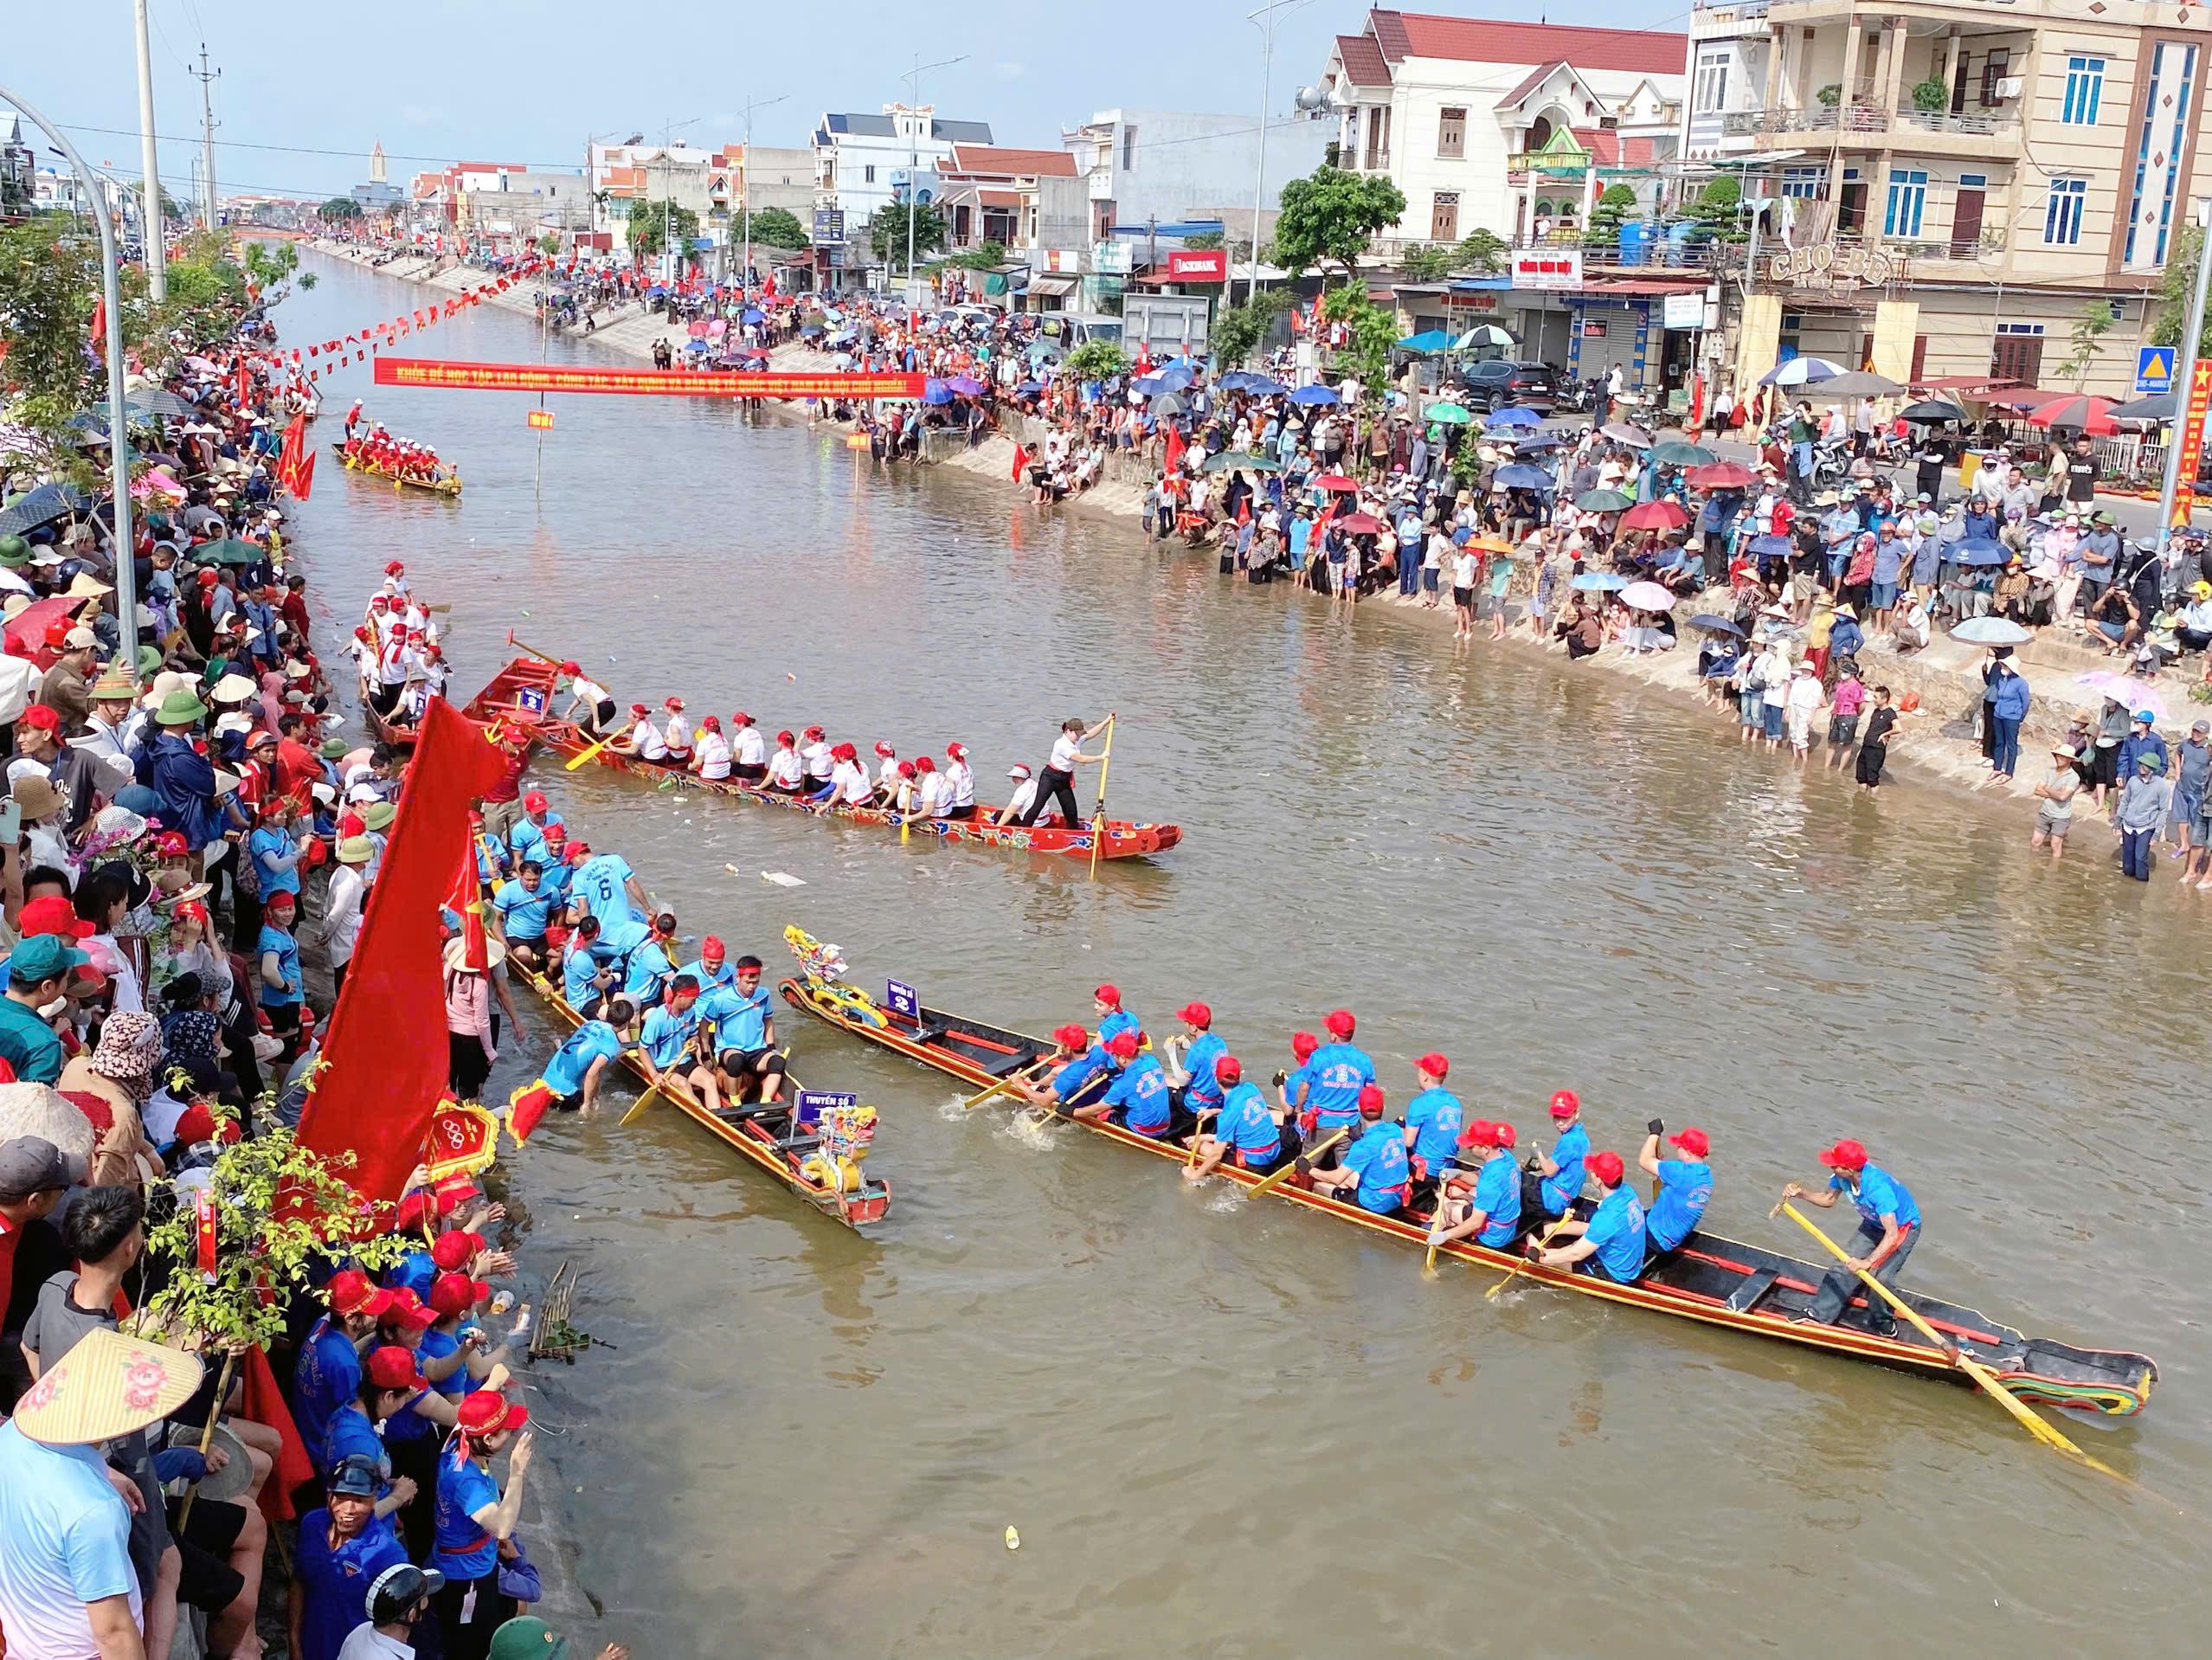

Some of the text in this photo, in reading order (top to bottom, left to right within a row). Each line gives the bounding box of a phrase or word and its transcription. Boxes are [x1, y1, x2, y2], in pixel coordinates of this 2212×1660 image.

[396, 363, 427, 382] KHỎE
[429, 364, 445, 381] ĐỂ
[447, 369, 469, 385] HỌC
[497, 372, 518, 385] LAO
[556, 372, 586, 389] CÔNG
[614, 375, 634, 389] XÂY
[637, 376, 666, 391] DỰNG
[685, 376, 705, 390] BẢO
[708, 376, 721, 393] VỆ
[723, 376, 736, 392] TỔ
[738, 375, 765, 393] QUỐC
[768, 378, 789, 395] VIỆT
[791, 380, 814, 392] NAM
[817, 378, 831, 392] XÃ
[833, 378, 850, 396] HỘI
[852, 376, 871, 392] CHỦ
[598, 878, 612, 901] 6
[894, 995, 910, 1012] 2
